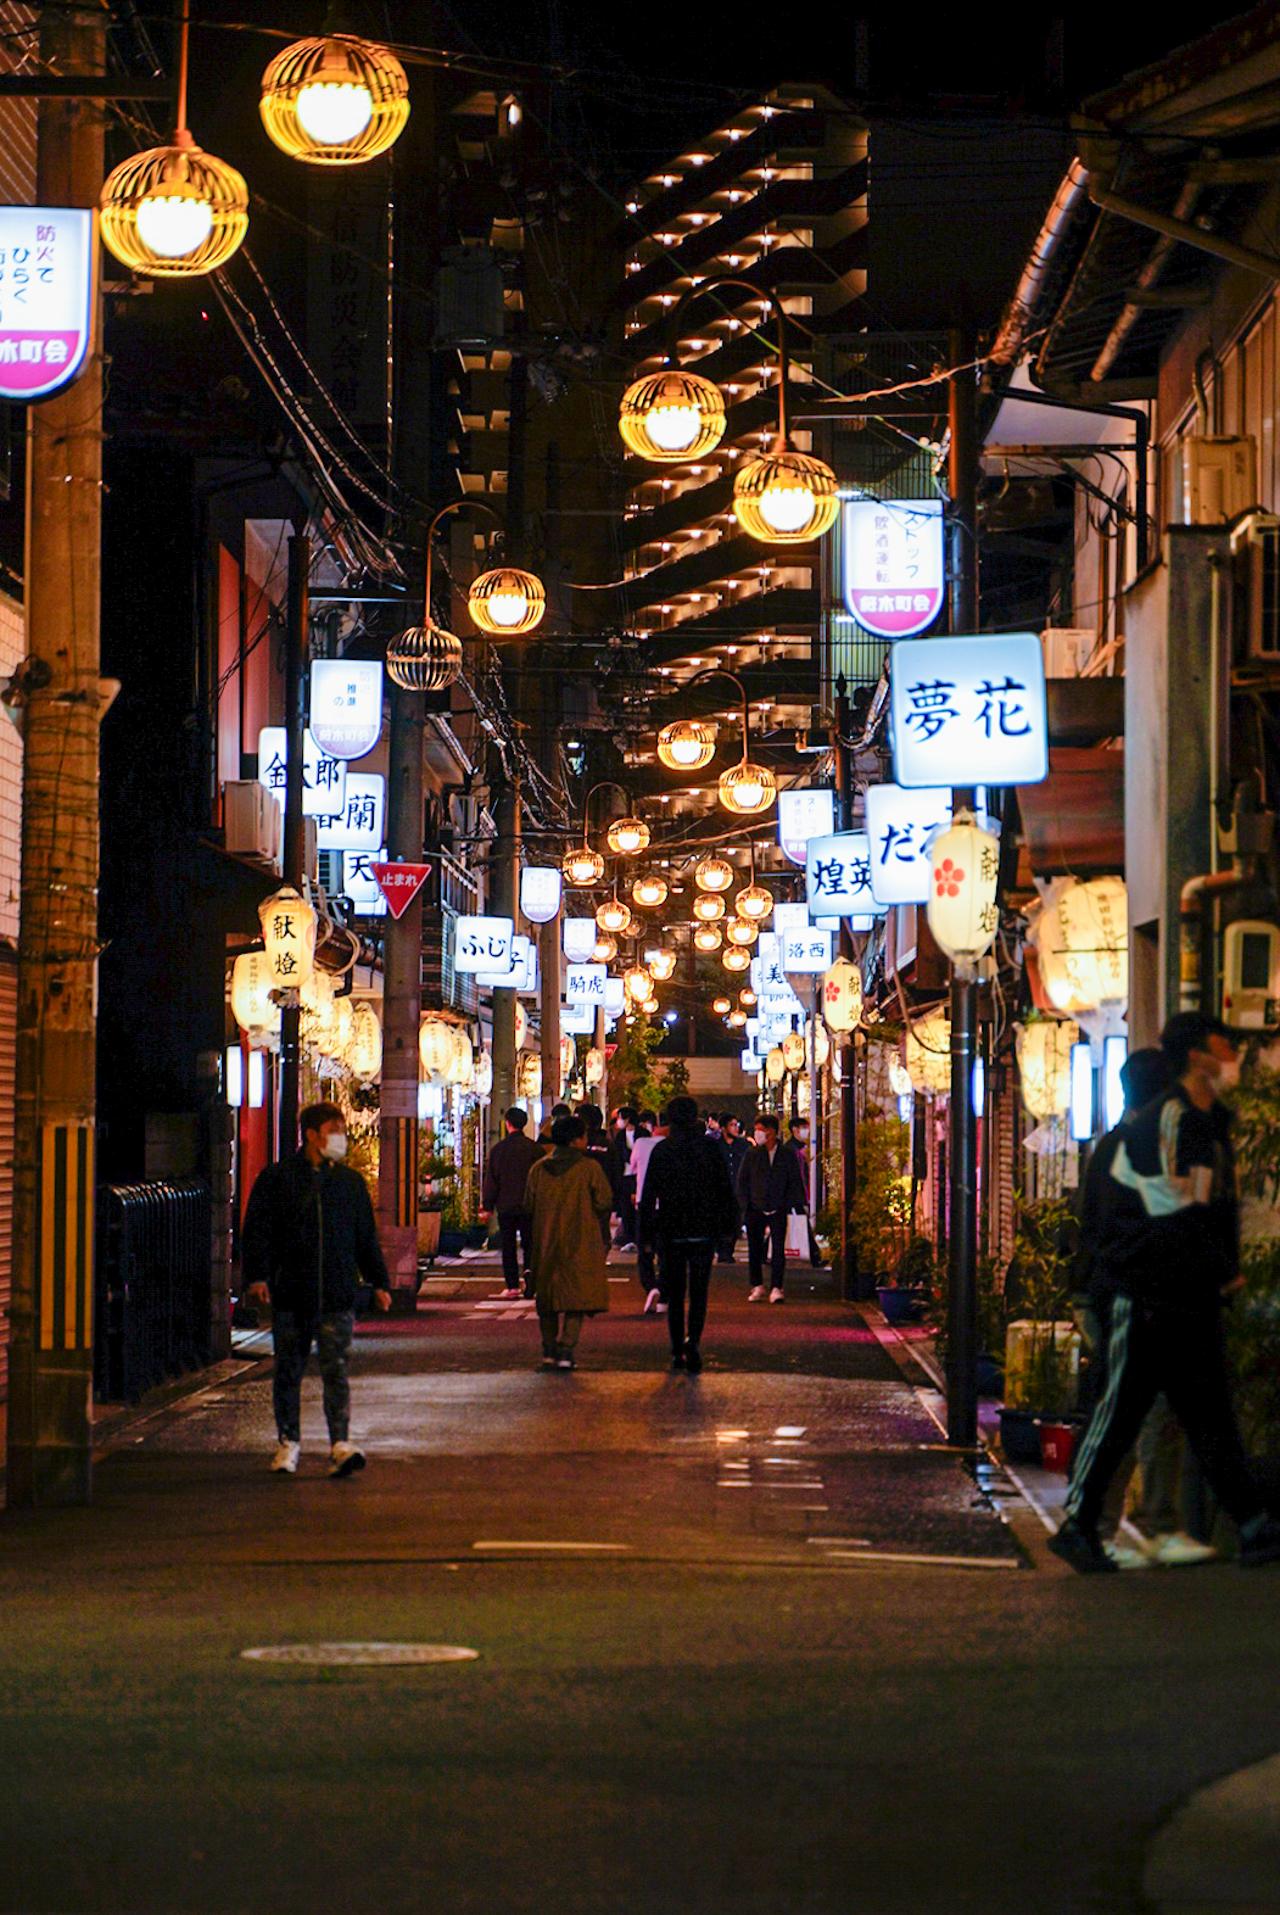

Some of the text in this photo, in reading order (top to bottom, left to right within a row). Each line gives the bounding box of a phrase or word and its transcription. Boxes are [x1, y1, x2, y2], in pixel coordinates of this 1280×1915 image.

[331, 172, 361, 414] 信防災会館
[904, 676, 1032, 743] 夢花
[381, 872, 419, 887] 止まれ
[812, 856, 872, 897] 煌英
[462, 934, 507, 958] ふじ
[788, 942, 824, 959] 洛西
[569, 975, 604, 995] 騎虎
